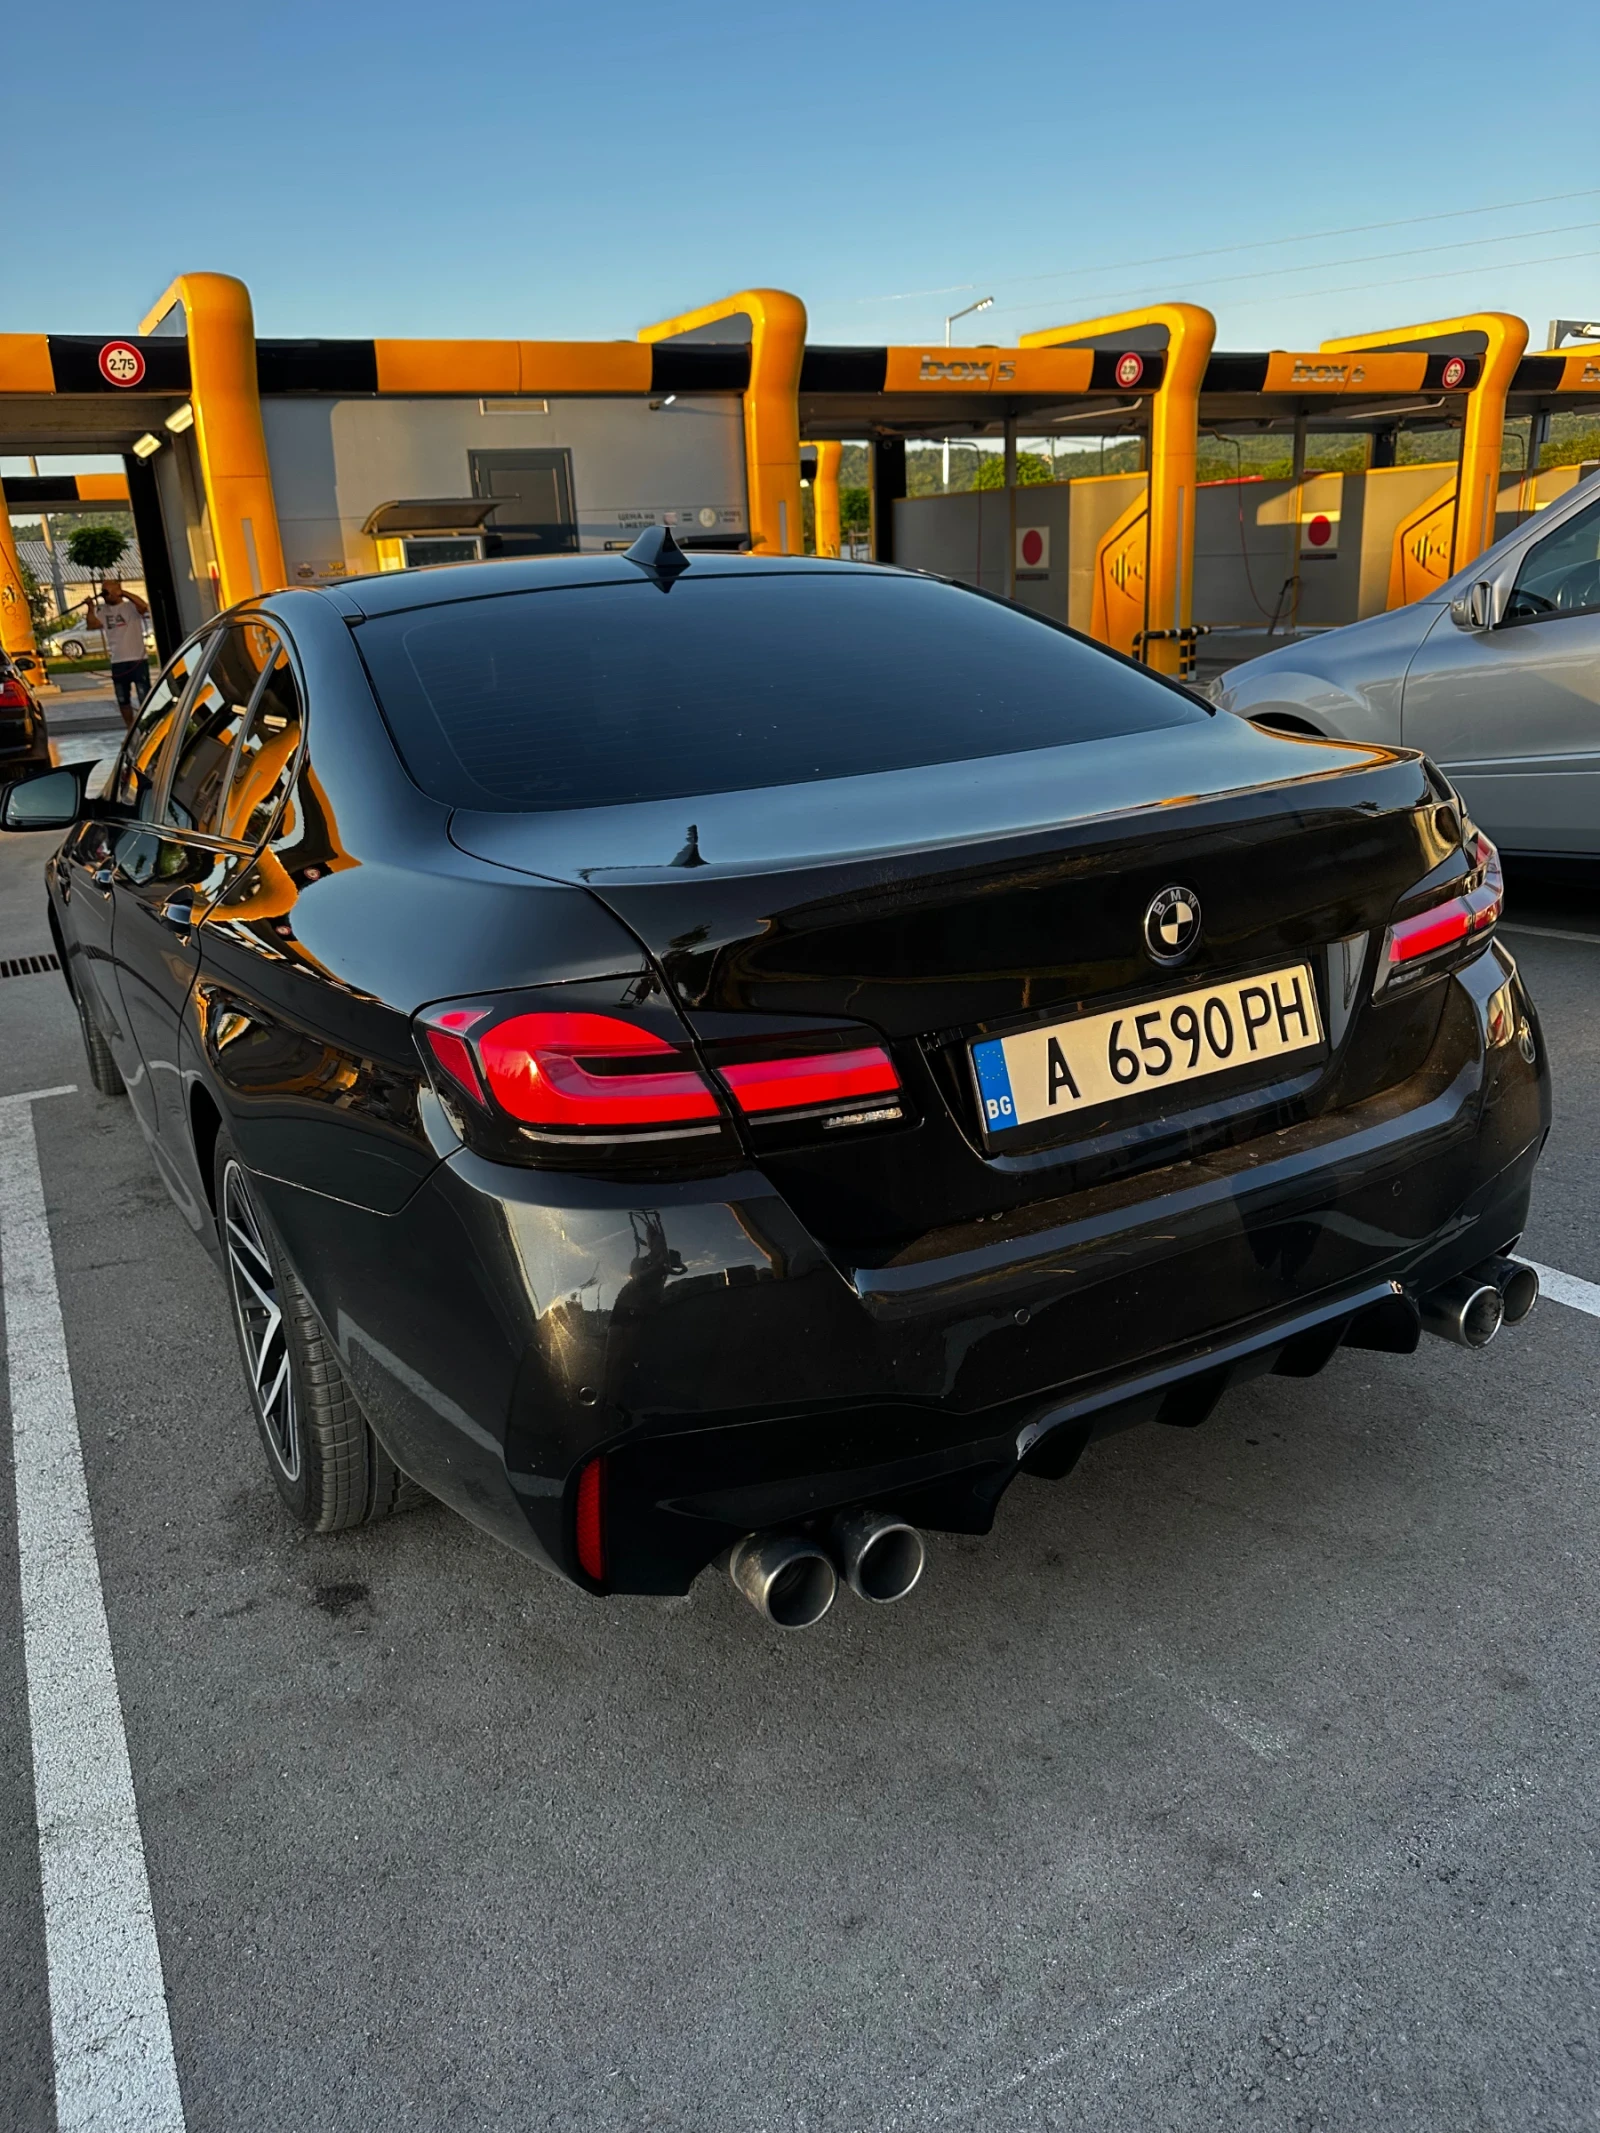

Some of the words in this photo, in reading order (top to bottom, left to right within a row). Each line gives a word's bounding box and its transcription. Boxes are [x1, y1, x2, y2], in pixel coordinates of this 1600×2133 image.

[109, 358, 136, 372] 2.75
[918, 355, 993, 381] box
[996, 361, 1017, 382] 5
[1291, 359, 1348, 382] box
[1153, 889, 1198, 915] BMW
[1048, 1037, 1081, 1106] A
[987, 1095, 1013, 1119] BG
